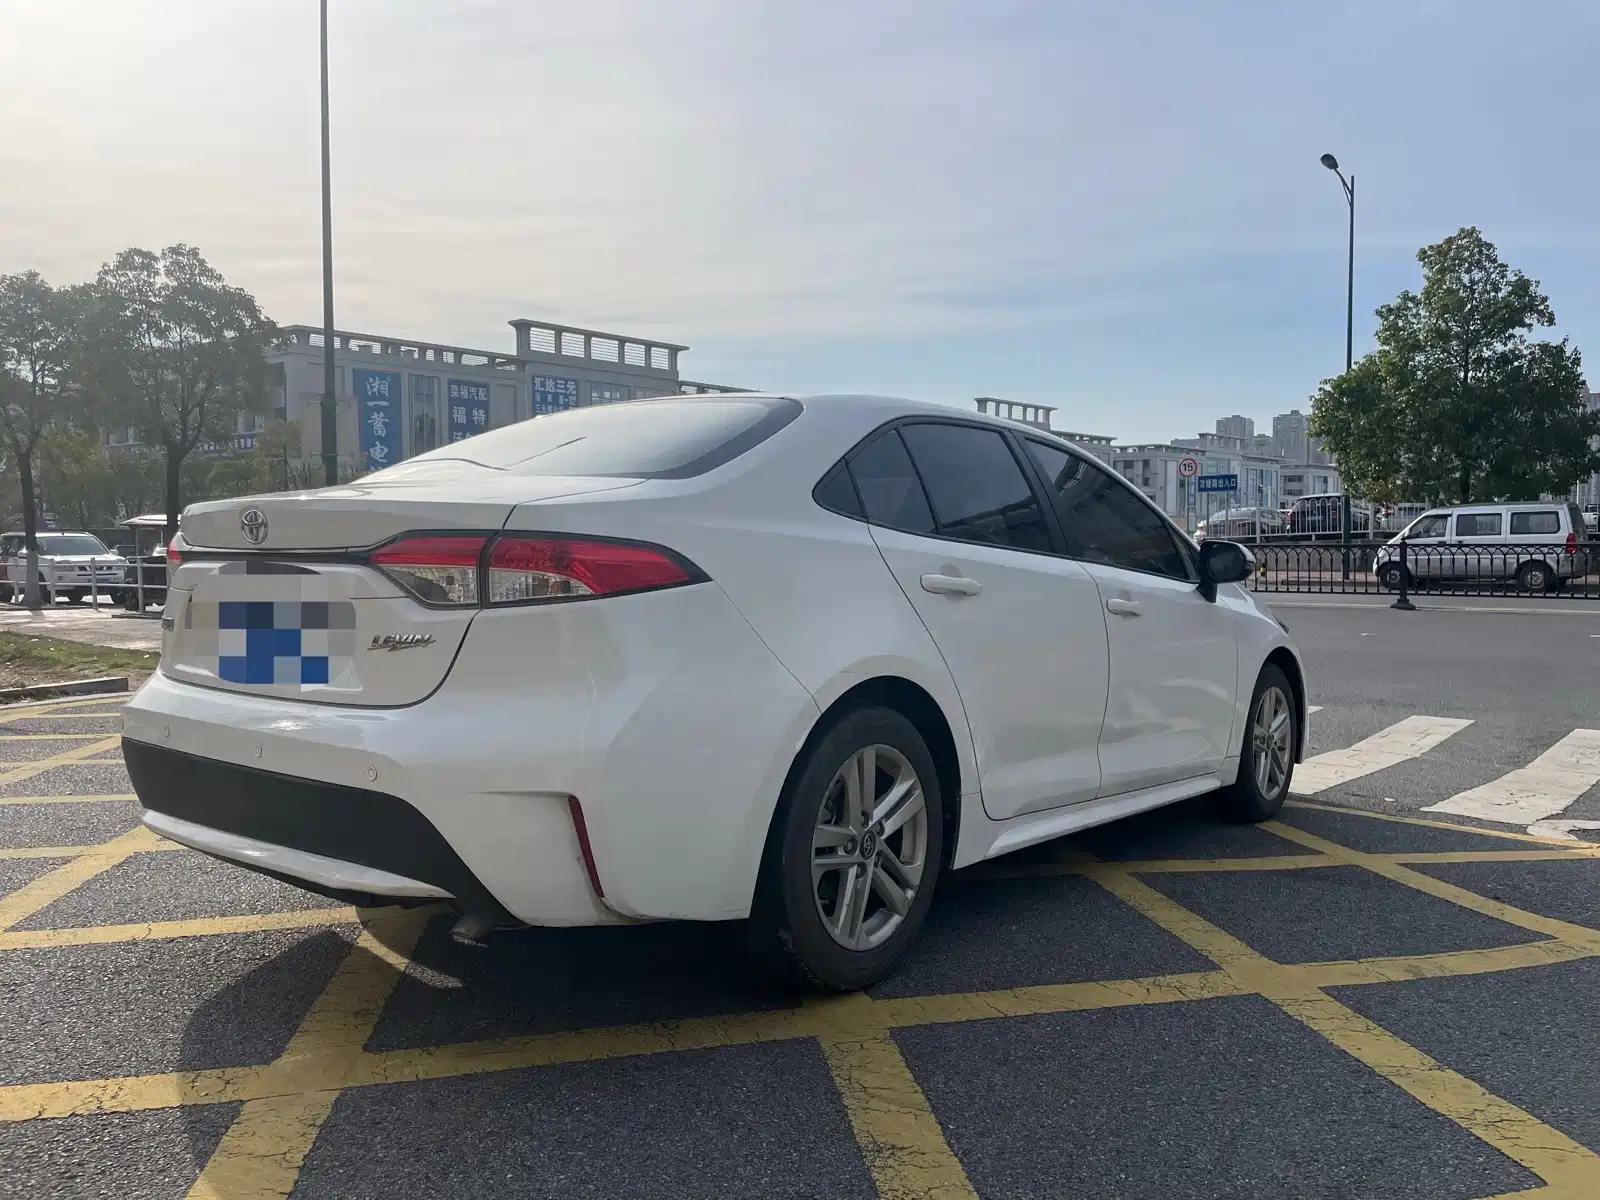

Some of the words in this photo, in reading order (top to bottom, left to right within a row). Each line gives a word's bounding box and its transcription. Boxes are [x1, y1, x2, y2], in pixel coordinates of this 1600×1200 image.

[534, 376, 577, 395] 汇达三元
[452, 406, 487, 426] 福特
[1182, 462, 1194, 472] 15
[369, 633, 434, 650] LEVIN
